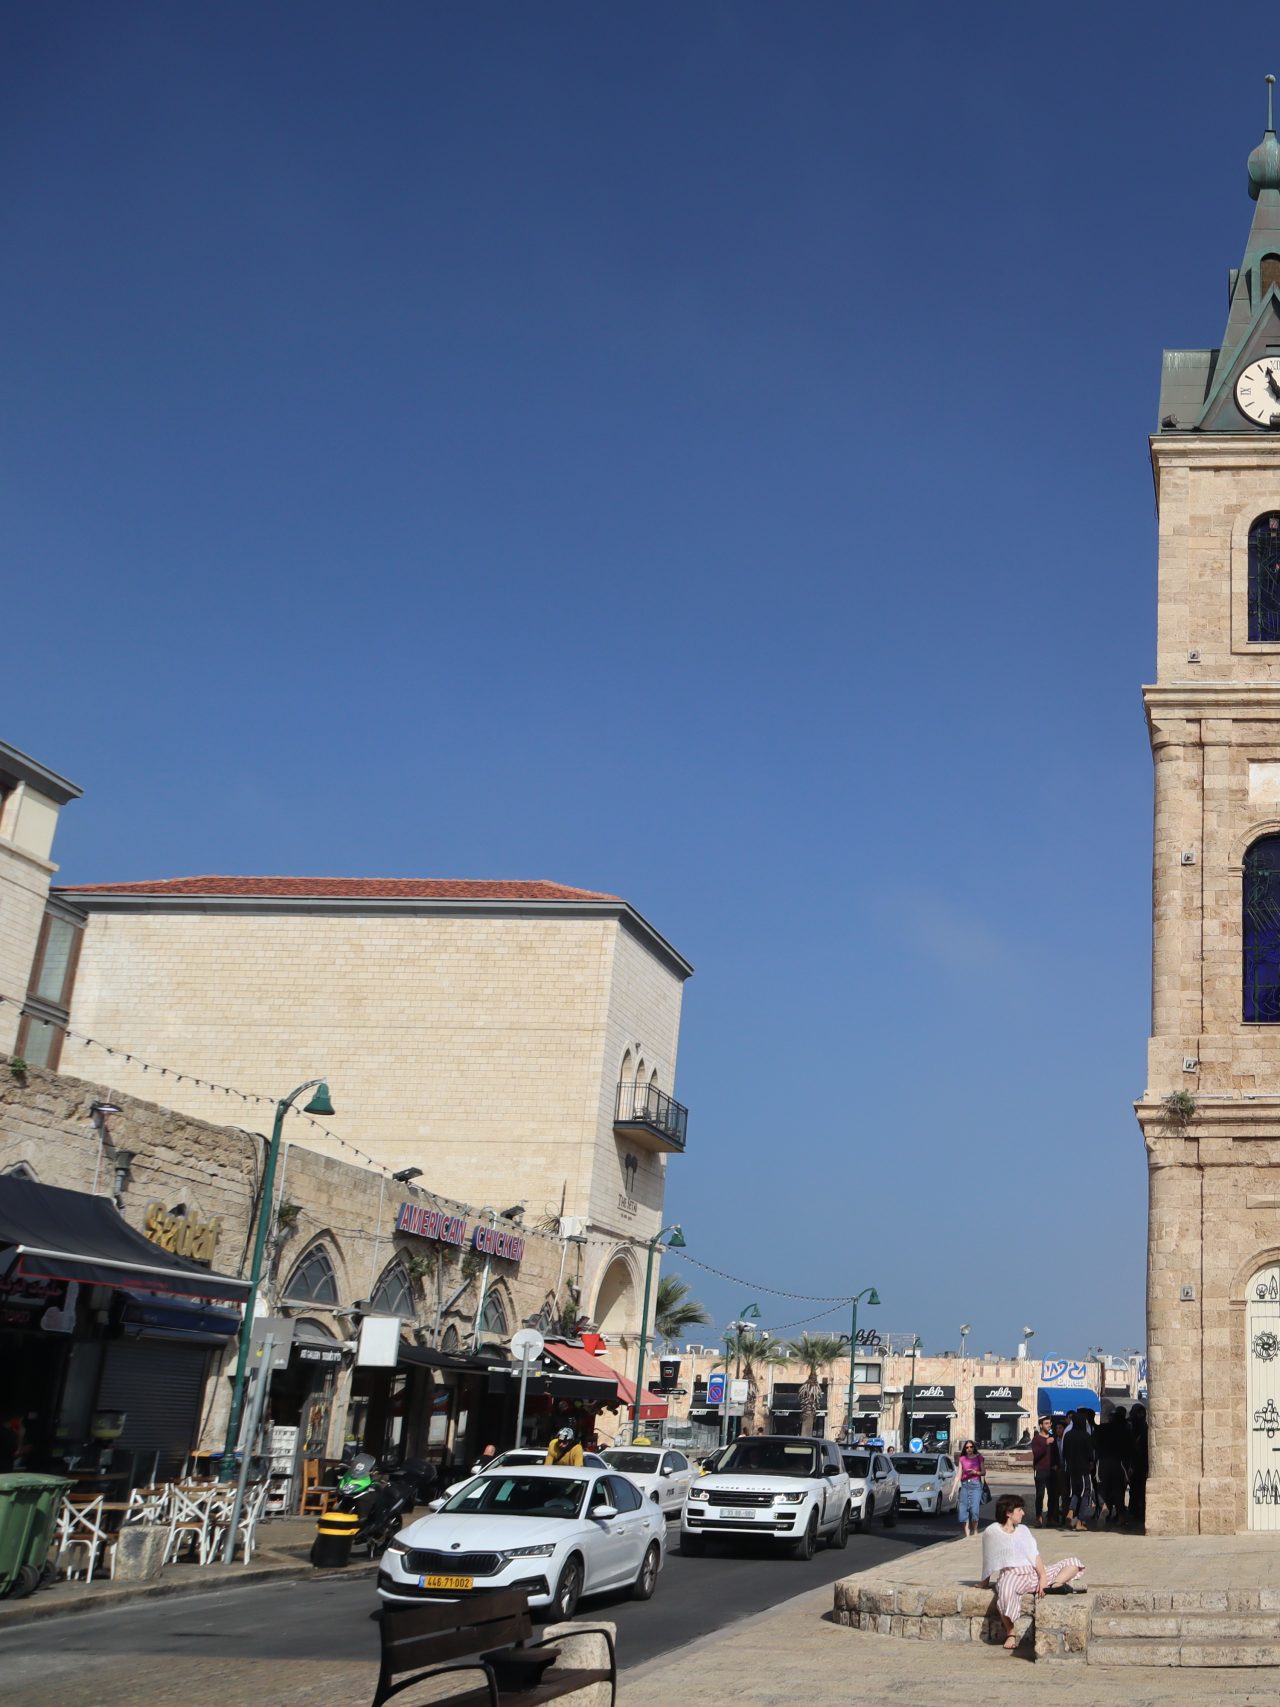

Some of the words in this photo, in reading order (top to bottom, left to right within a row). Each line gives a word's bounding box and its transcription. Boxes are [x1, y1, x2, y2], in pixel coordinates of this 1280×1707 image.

[143, 1202, 224, 1260] Sadaf
[399, 1203, 467, 1246] AMERICAN
[475, 1225, 526, 1261] CHICKEN
